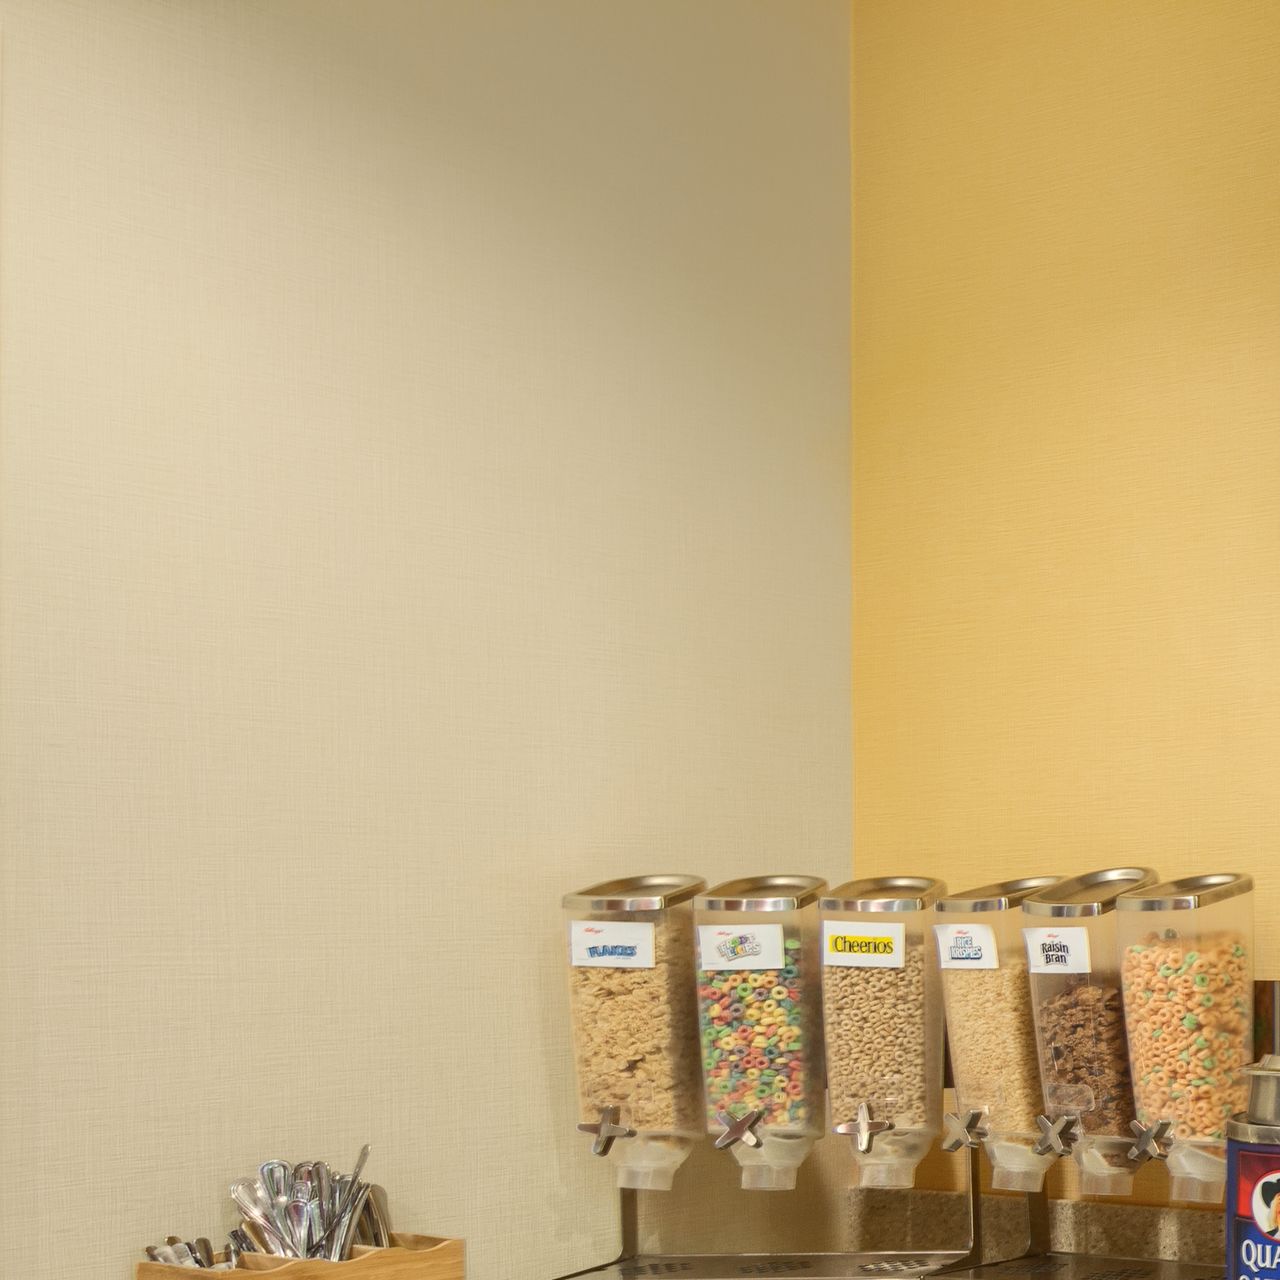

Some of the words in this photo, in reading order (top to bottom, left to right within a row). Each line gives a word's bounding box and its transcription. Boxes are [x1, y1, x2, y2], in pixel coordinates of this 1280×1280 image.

[834, 935, 894, 955] Cheerios
[1041, 941, 1070, 954] Raisin
[1045, 952, 1068, 964] Bran
